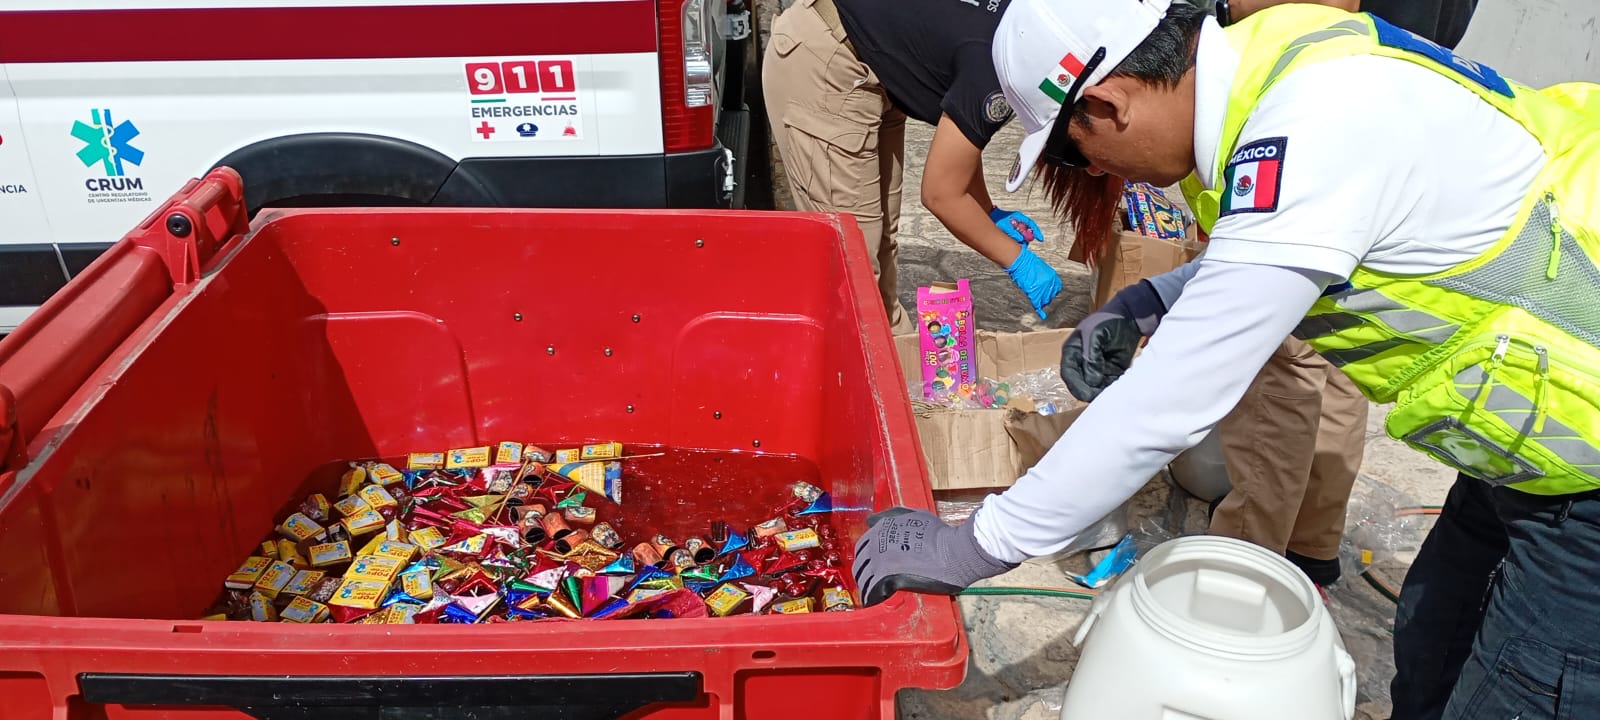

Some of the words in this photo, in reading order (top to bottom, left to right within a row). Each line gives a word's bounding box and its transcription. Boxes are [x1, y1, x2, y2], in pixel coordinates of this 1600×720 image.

[474, 65, 564, 91] 911
[472, 105, 578, 118] EMERGENCIAS
[85, 178, 143, 191] CRUM
[929, 351, 937, 366] 100
[960, 349, 968, 361] DE
